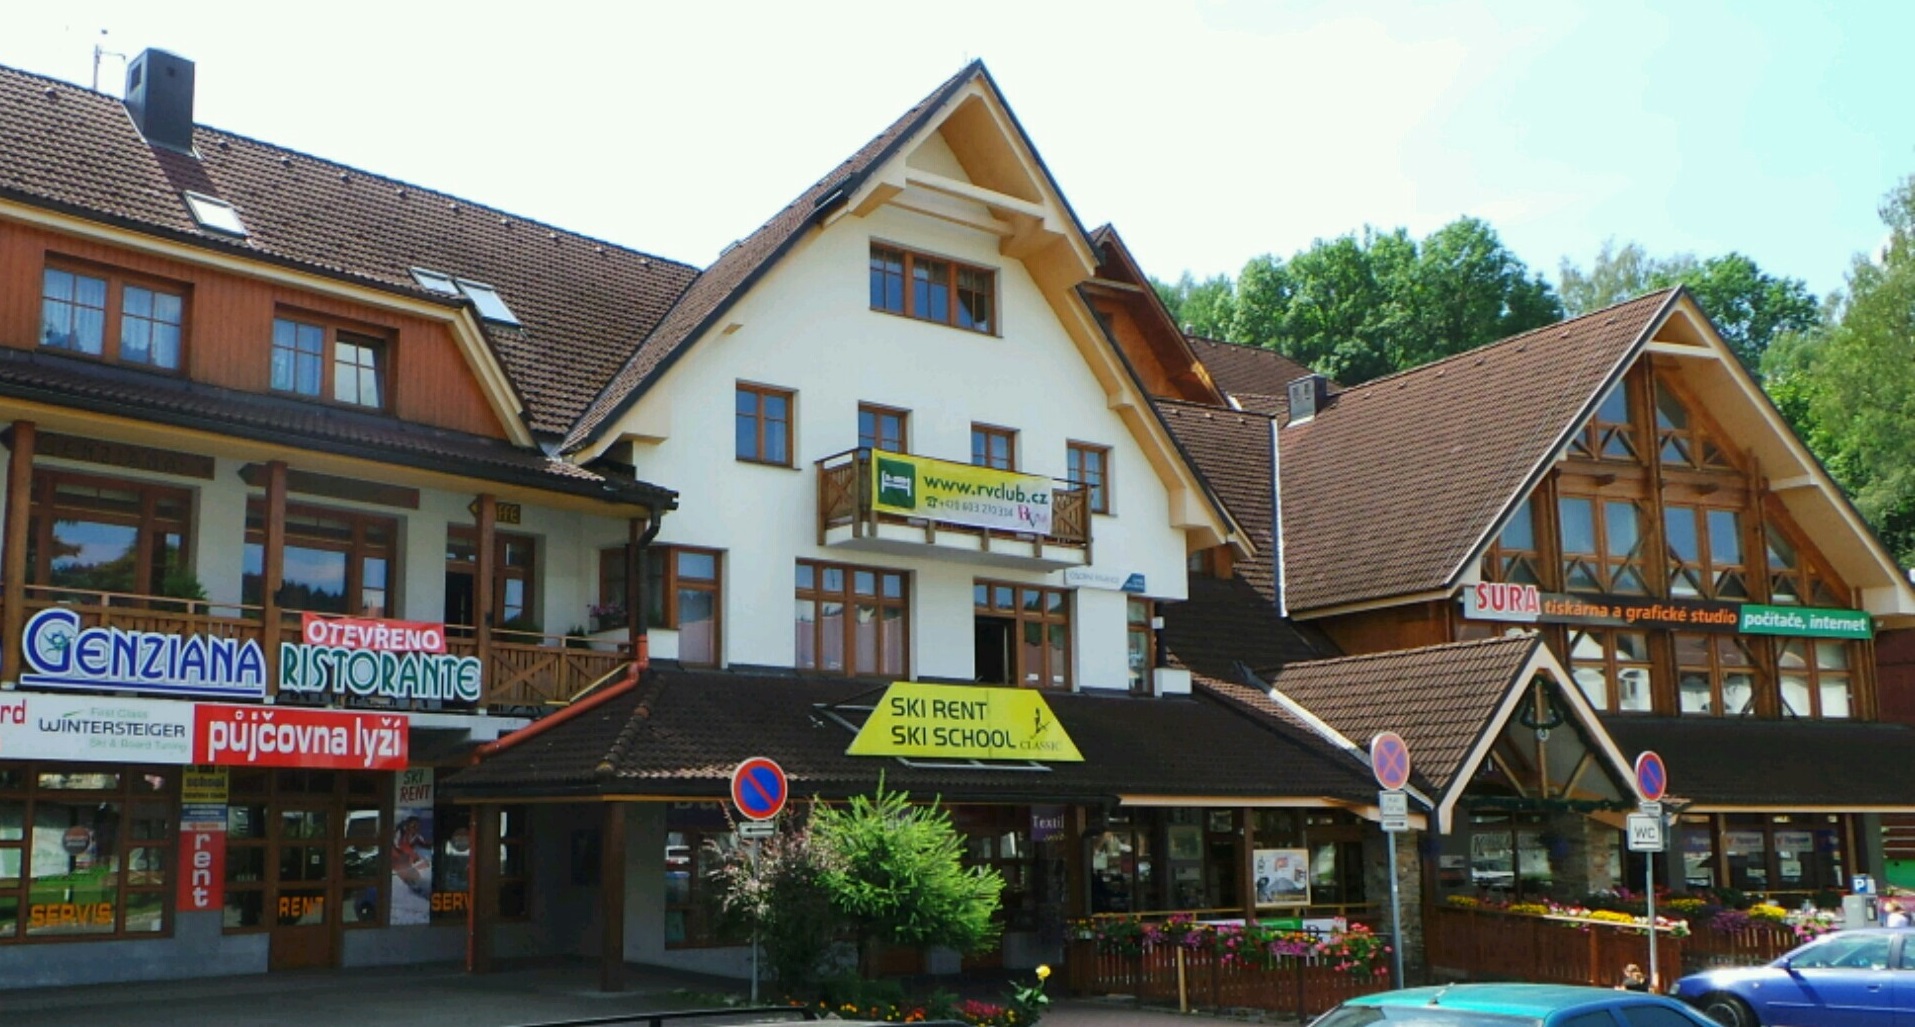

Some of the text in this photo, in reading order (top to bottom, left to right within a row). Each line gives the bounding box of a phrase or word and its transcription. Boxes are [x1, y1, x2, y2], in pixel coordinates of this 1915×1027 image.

[923, 475, 1049, 505] www.rvclub.cz
[1475, 582, 1540, 614] SURA
[1544, 599, 1609, 616] tiskárna
[1612, 605, 1622, 617] a
[1625, 604, 1687, 623] grafické
[1690, 608, 1737, 624] studio
[1809, 613, 1867, 632] internet
[306, 619, 441, 650] OTEVŘENO
[23, 609, 264, 685] GENZIANA
[280, 643, 480, 699] RISTORANTE
[891, 697, 988, 721] SKI RENT
[38, 717, 186, 738] WINTERSTEIGER
[207, 709, 401, 769] půjčovna lyží
[891, 725, 1017, 749] SKI SCHOOL
[403, 769, 425, 786] SKI
[400, 784, 432, 803] RENT
[1032, 813, 1065, 829] Textil
[1634, 826, 1656, 839] WC
[191, 833, 212, 908] rent
[1853, 879, 1865, 891] P
[30, 903, 112, 927] SERVIS
[278, 896, 325, 918] RENT
